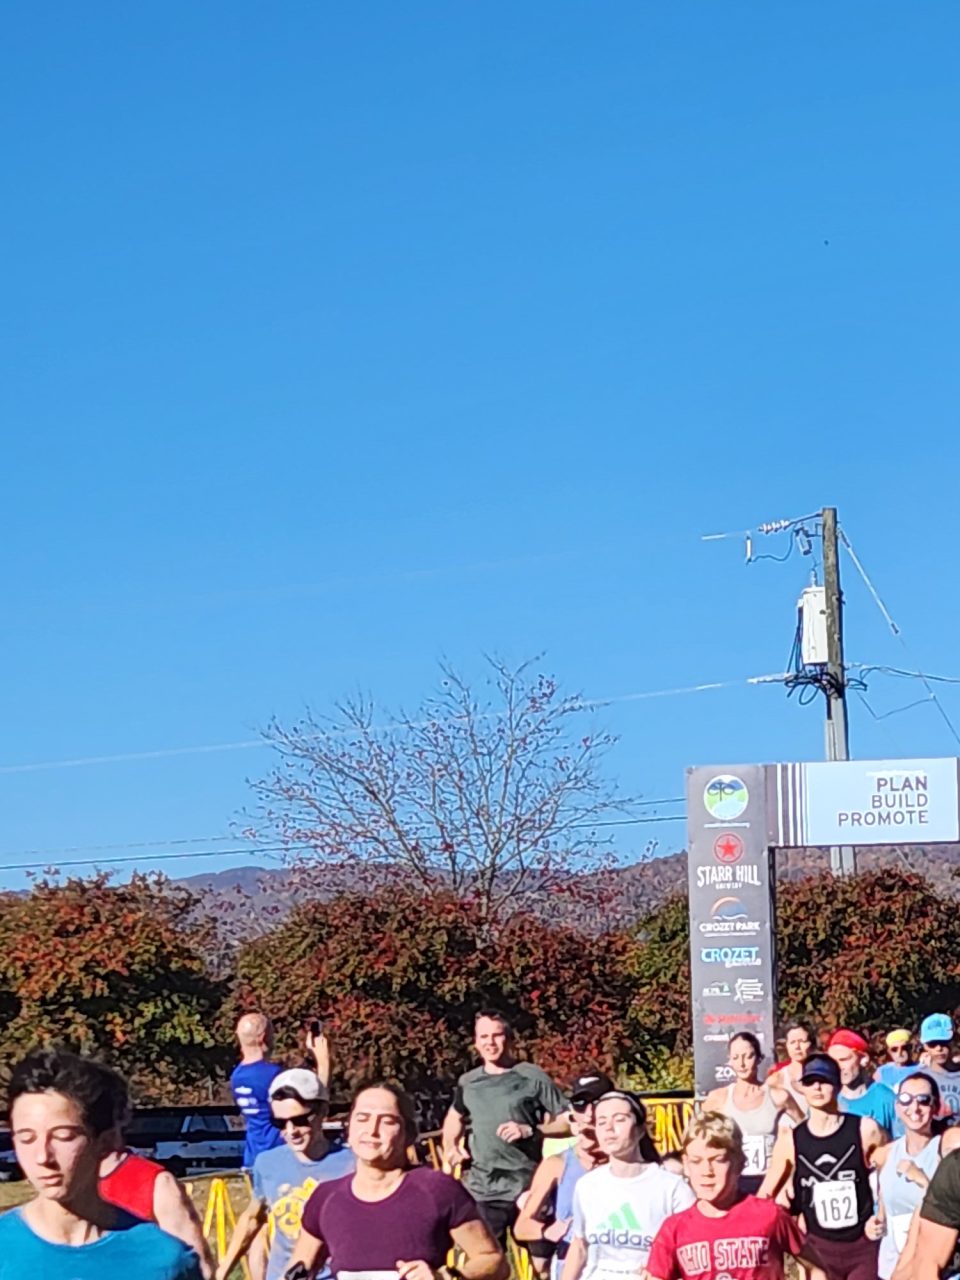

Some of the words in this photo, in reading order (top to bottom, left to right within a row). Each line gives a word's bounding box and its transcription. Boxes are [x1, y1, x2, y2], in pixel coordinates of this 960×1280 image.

[877, 775, 928, 792] PLAN
[872, 793, 929, 809] BUILD
[838, 810, 929, 827] PROMOTE
[697, 865, 733, 887] STARR
[736, 864, 762, 886] HILL
[701, 947, 759, 963] CROZET
[820, 1195, 853, 1222] 162
[588, 1228, 652, 1248] adidas
[715, 1238, 769, 1268] STATE
